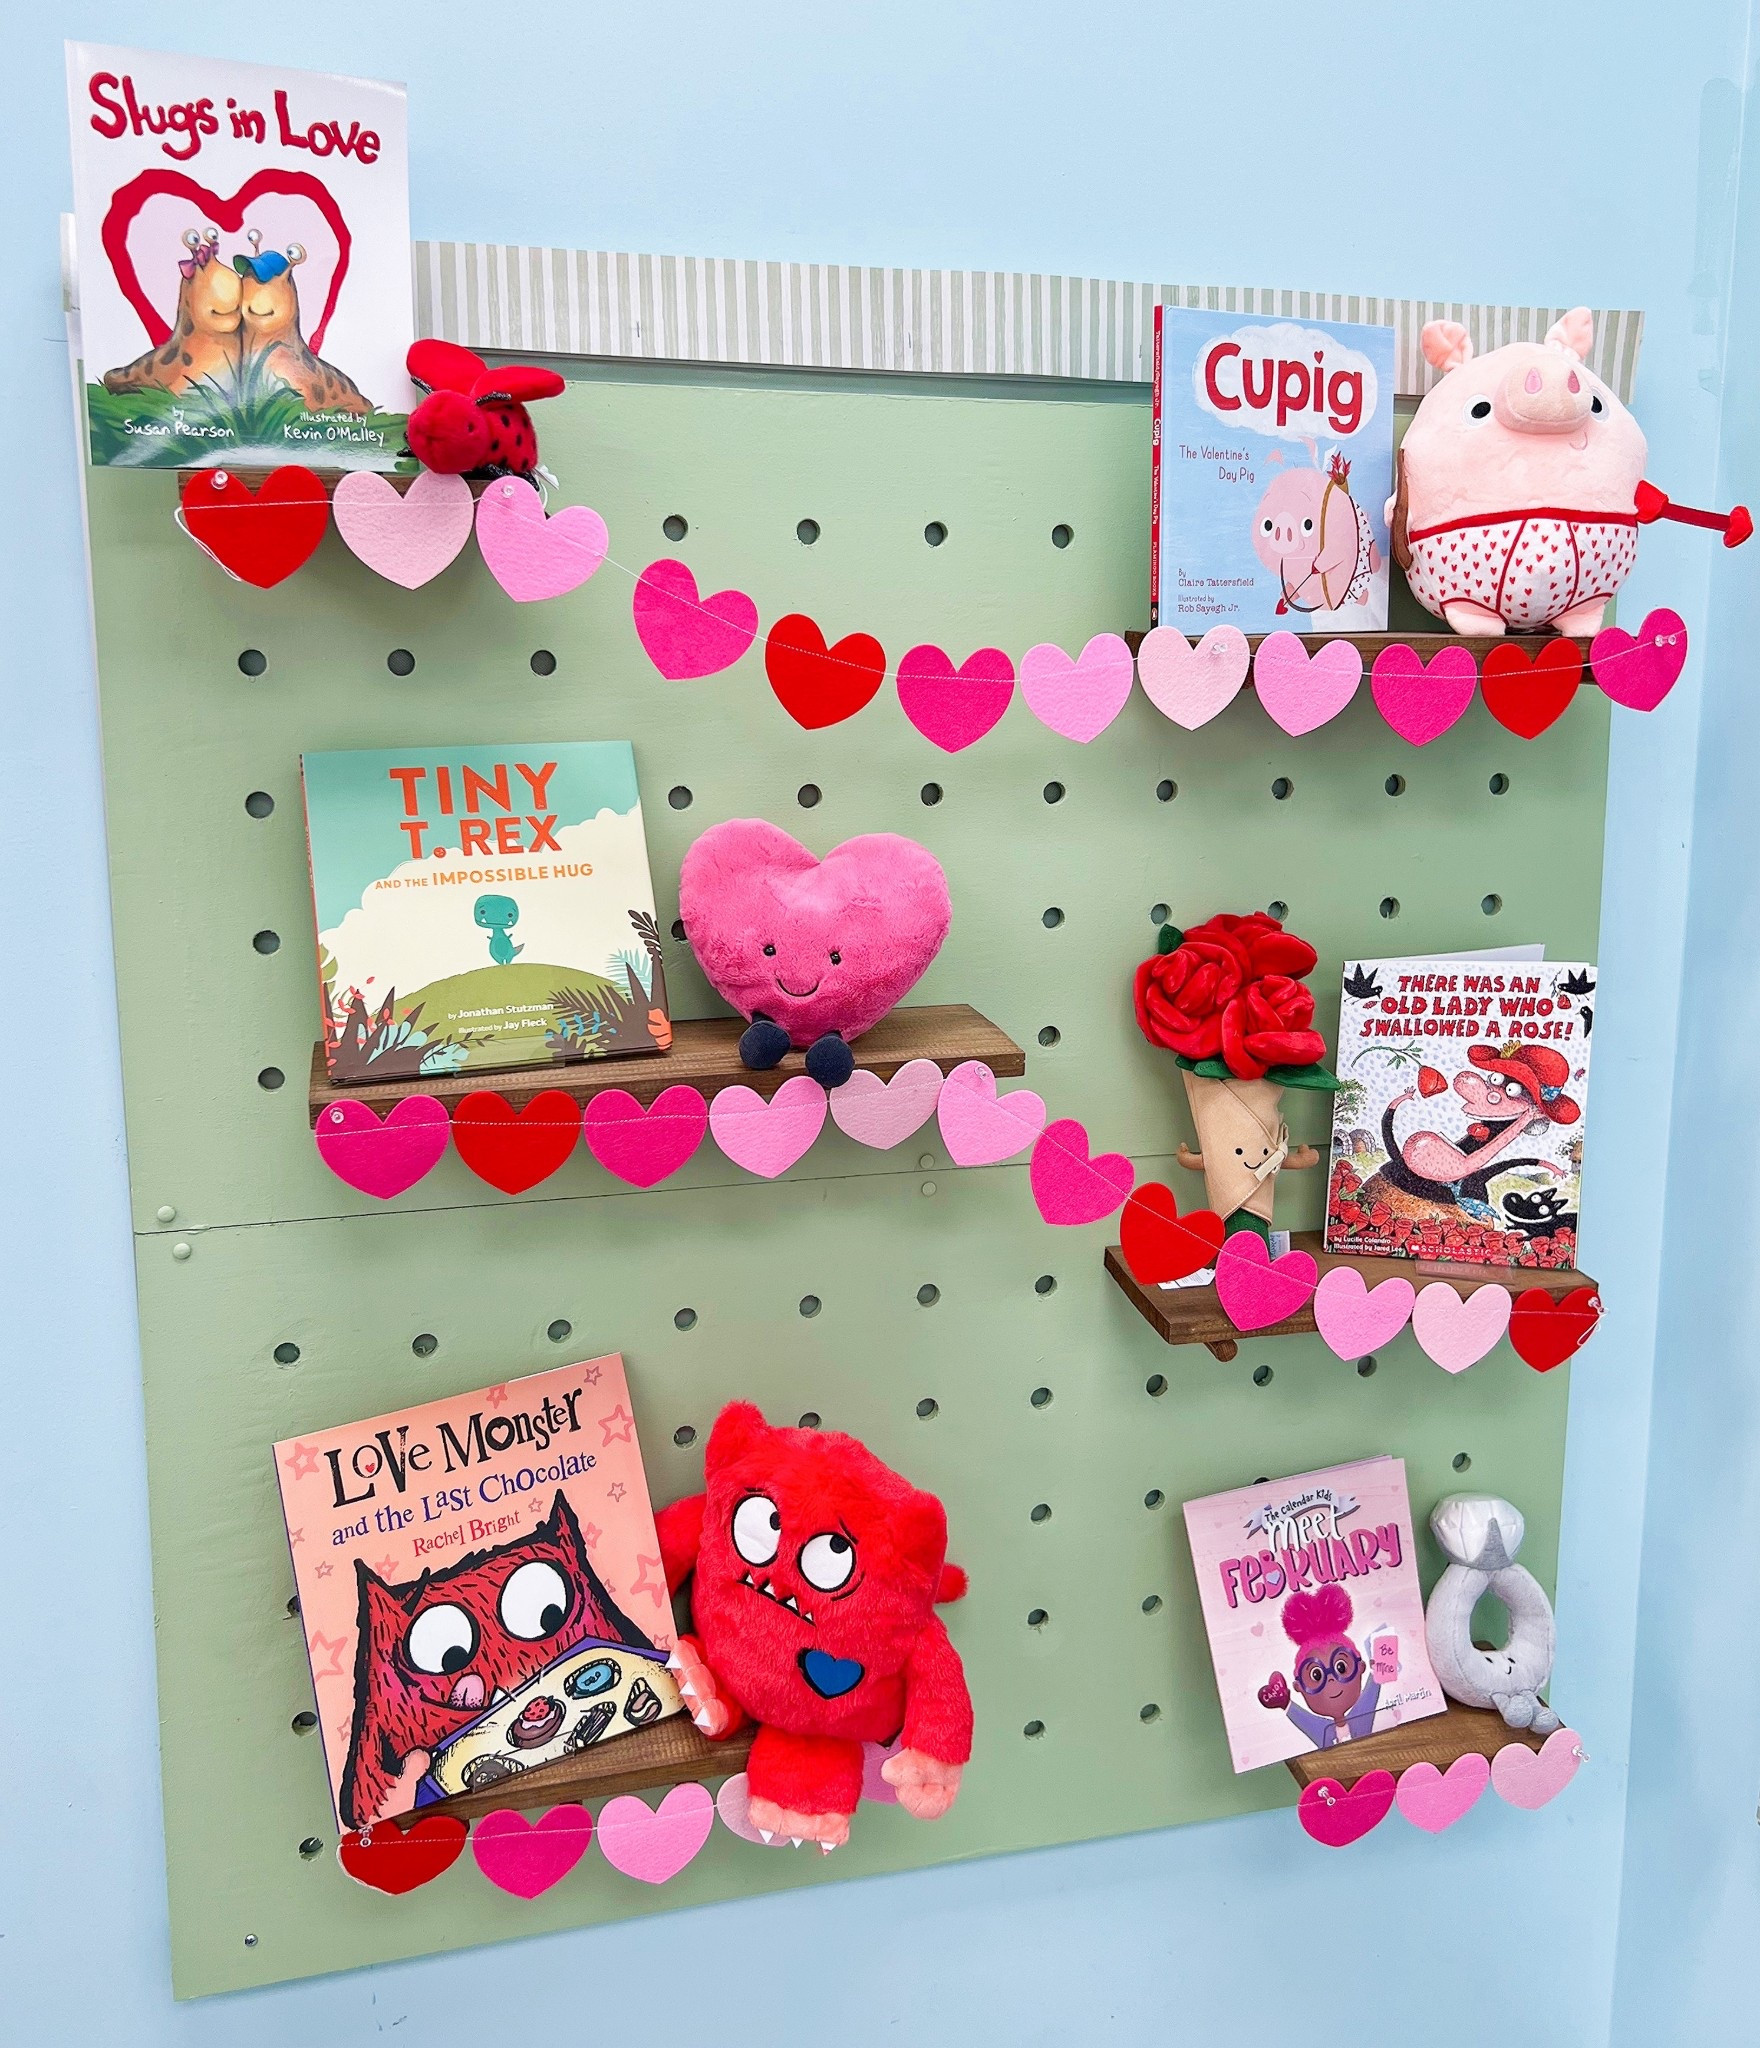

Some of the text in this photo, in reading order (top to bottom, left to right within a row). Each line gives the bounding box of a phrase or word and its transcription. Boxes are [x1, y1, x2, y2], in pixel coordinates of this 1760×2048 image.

[89, 71, 382, 164] Slugs in Love
[1204, 342, 1363, 434] Cupig
[172, 406, 184, 420] by
[300, 411, 367, 427] illustrated by
[124, 419, 235, 438] Susan Pearson
[283, 424, 384, 447] Kevin O'Malley
[1179, 445, 1250, 461] The Valentine's
[1219, 466, 1255, 483] Day Pig
[1178, 568, 1186, 578] By
[1178, 578, 1254, 587] Claire Tattersfield
[1178, 604, 1194, 612] Rob
[1228, 604, 1240, 612] Jr.
[1208, 594, 1215, 603] by
[389, 762, 558, 816] TINY
[400, 814, 562, 860] T. REX
[375, 863, 594, 890] AND THE IMPOSSIBLE HUG
[1398, 974, 1541, 994] THERE WAS AN
[457, 1007, 504, 1019] Jonathan
[505, 1003, 554, 1014] Stutzman
[1380, 996, 1554, 1016] OLD LADY WHO
[494, 1024, 503, 1032] by
[503, 1021, 520, 1031] Jay
[521, 1018, 548, 1028] Fleck
[1359, 1018, 1574, 1042] SWALLOWED A ROSE!
[1421, 1245, 1492, 1256] SCHOLASTIC
[436, 1388, 582, 1473] Monster
[332, 1451, 597, 1547] and the Last Chocolate
[1264, 1489, 1332, 1522] The Calendar Kids
[413, 1509, 521, 1557] Rachel Bright
[1379, 1644, 1394, 1655] Be
[1263, 1680, 1283, 1702] CANDY
